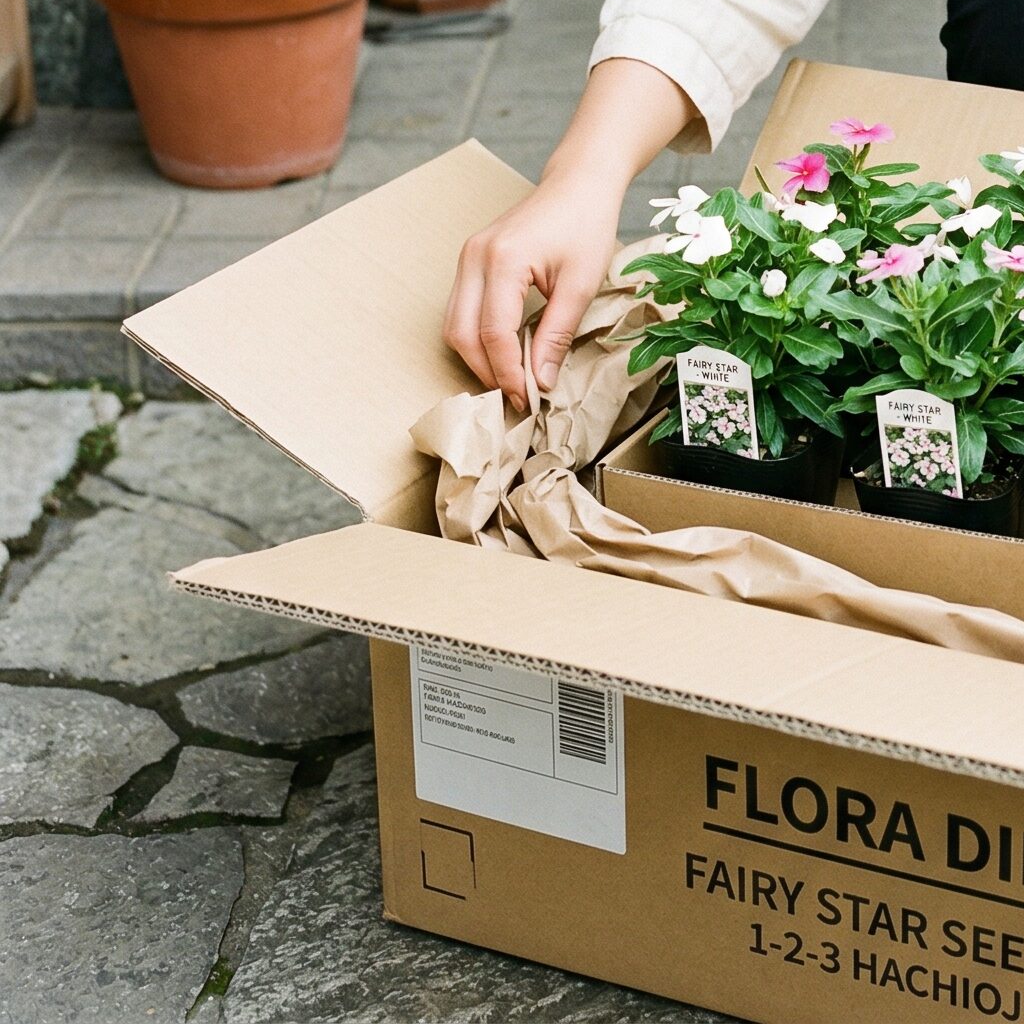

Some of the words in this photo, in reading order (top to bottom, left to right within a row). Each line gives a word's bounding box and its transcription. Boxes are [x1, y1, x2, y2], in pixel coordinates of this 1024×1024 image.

[687, 358, 712, 370] FAIRY
[715, 362, 739, 374] STAR
[888, 401, 914, 412] FAIRY
[917, 404, 942, 416] STAR
[903, 413, 933, 425] WHITE
[704, 753, 926, 863] FLORA
[684, 851, 806, 916] FAIRY
[815, 887, 929, 950] STAR
[748, 922, 842, 974] 1-2-3
